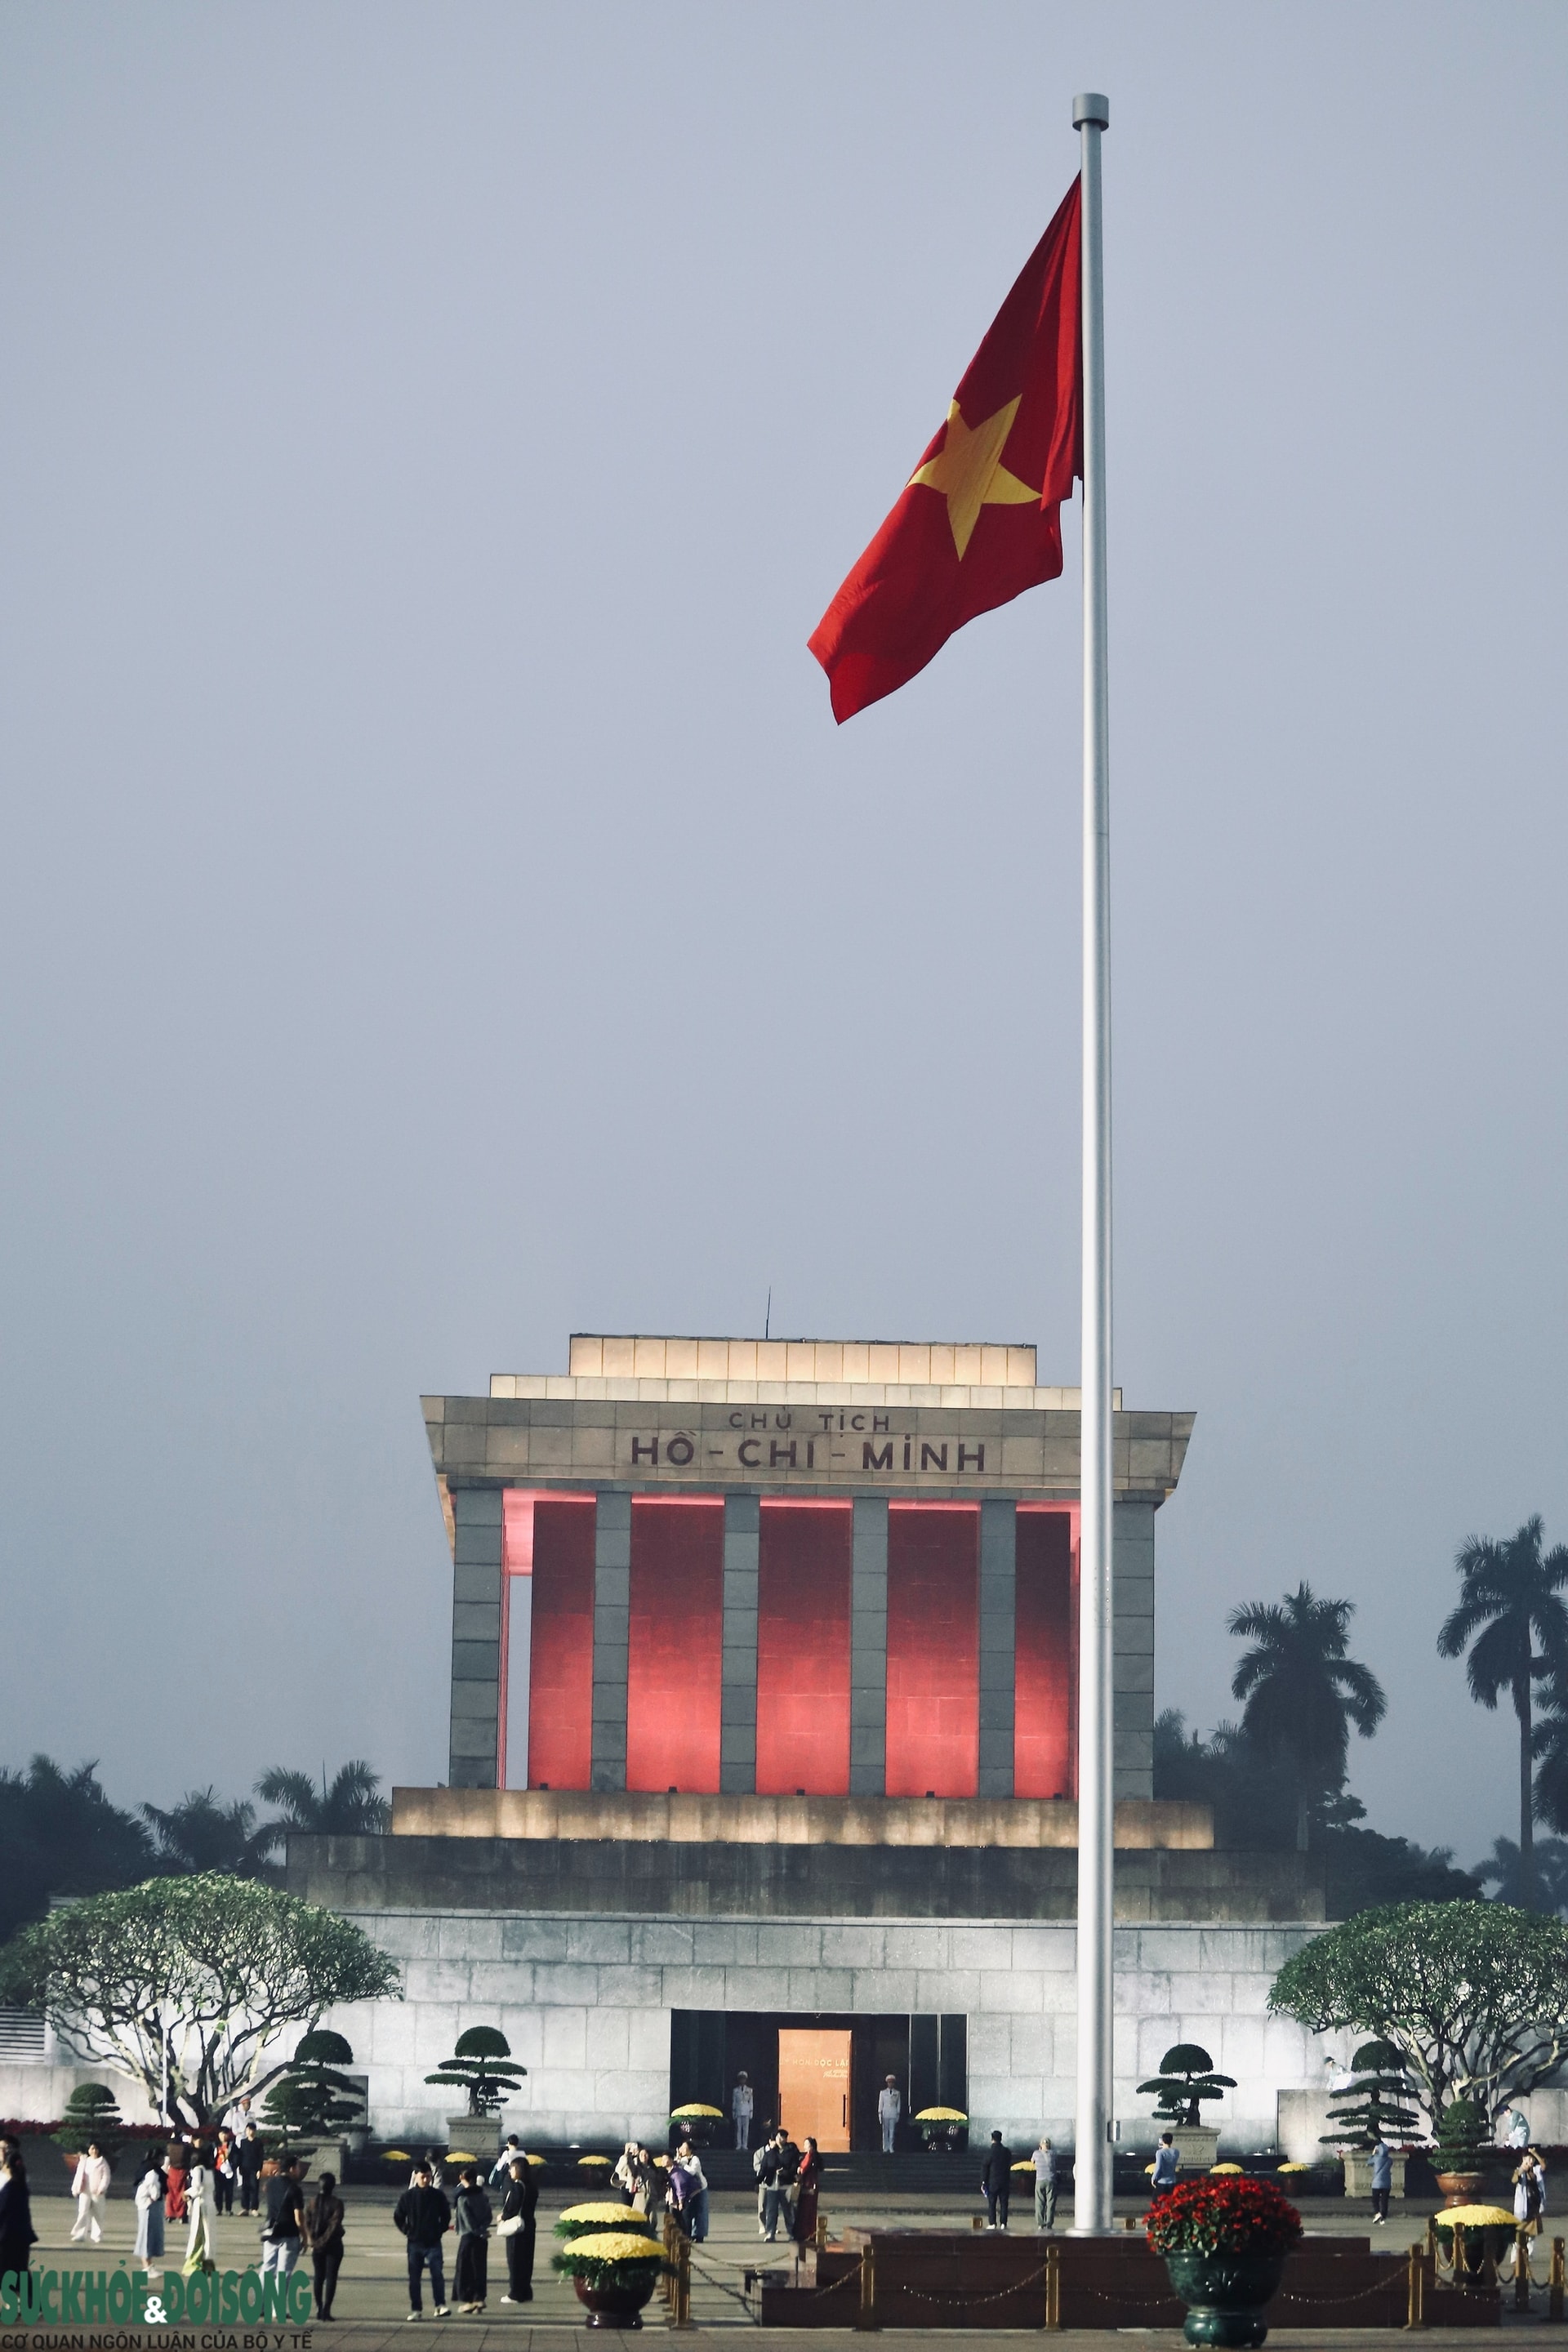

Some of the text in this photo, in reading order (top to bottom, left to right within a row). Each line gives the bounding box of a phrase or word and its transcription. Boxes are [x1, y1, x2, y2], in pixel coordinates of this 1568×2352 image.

[728, 1406, 889, 1438] CHỦ TỊCH
[631, 1430, 697, 1467] HỒ
